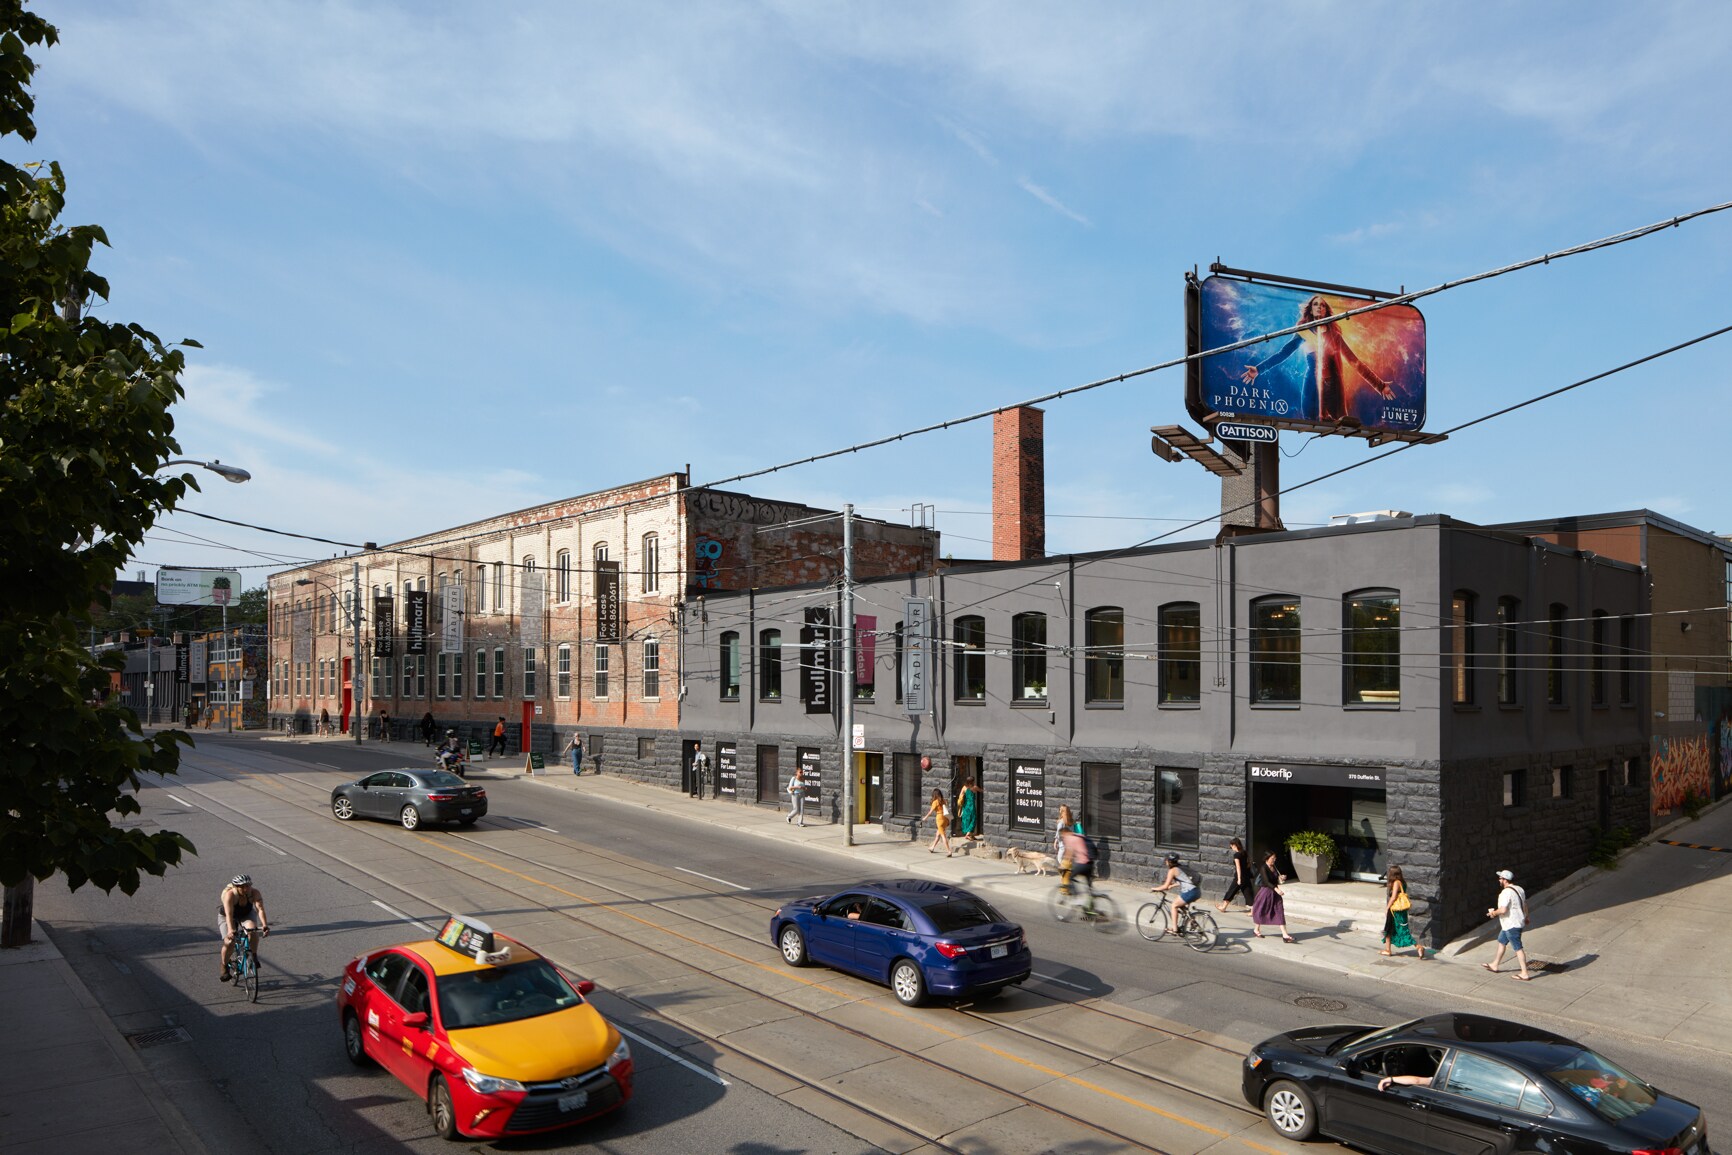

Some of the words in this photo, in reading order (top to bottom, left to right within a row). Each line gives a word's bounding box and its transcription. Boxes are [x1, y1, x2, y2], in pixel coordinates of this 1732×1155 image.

[1230, 385, 1270, 399] DARK
[1214, 395, 1288, 414] PHOENIX
[1381, 411, 1409, 421] JUNE
[1412, 413, 1417, 422] 7
[1221, 425, 1273, 439] PATTISON
[411, 597, 424, 650] hullmark
[912, 608, 920, 690] RADIATOR
[179, 647, 187, 680] hullmark
[1016, 779, 1031, 787] Retail
[1026, 788, 1042, 796] Lease
[1030, 799, 1042, 807] 1710
[1017, 815, 1040, 824] hullmark
